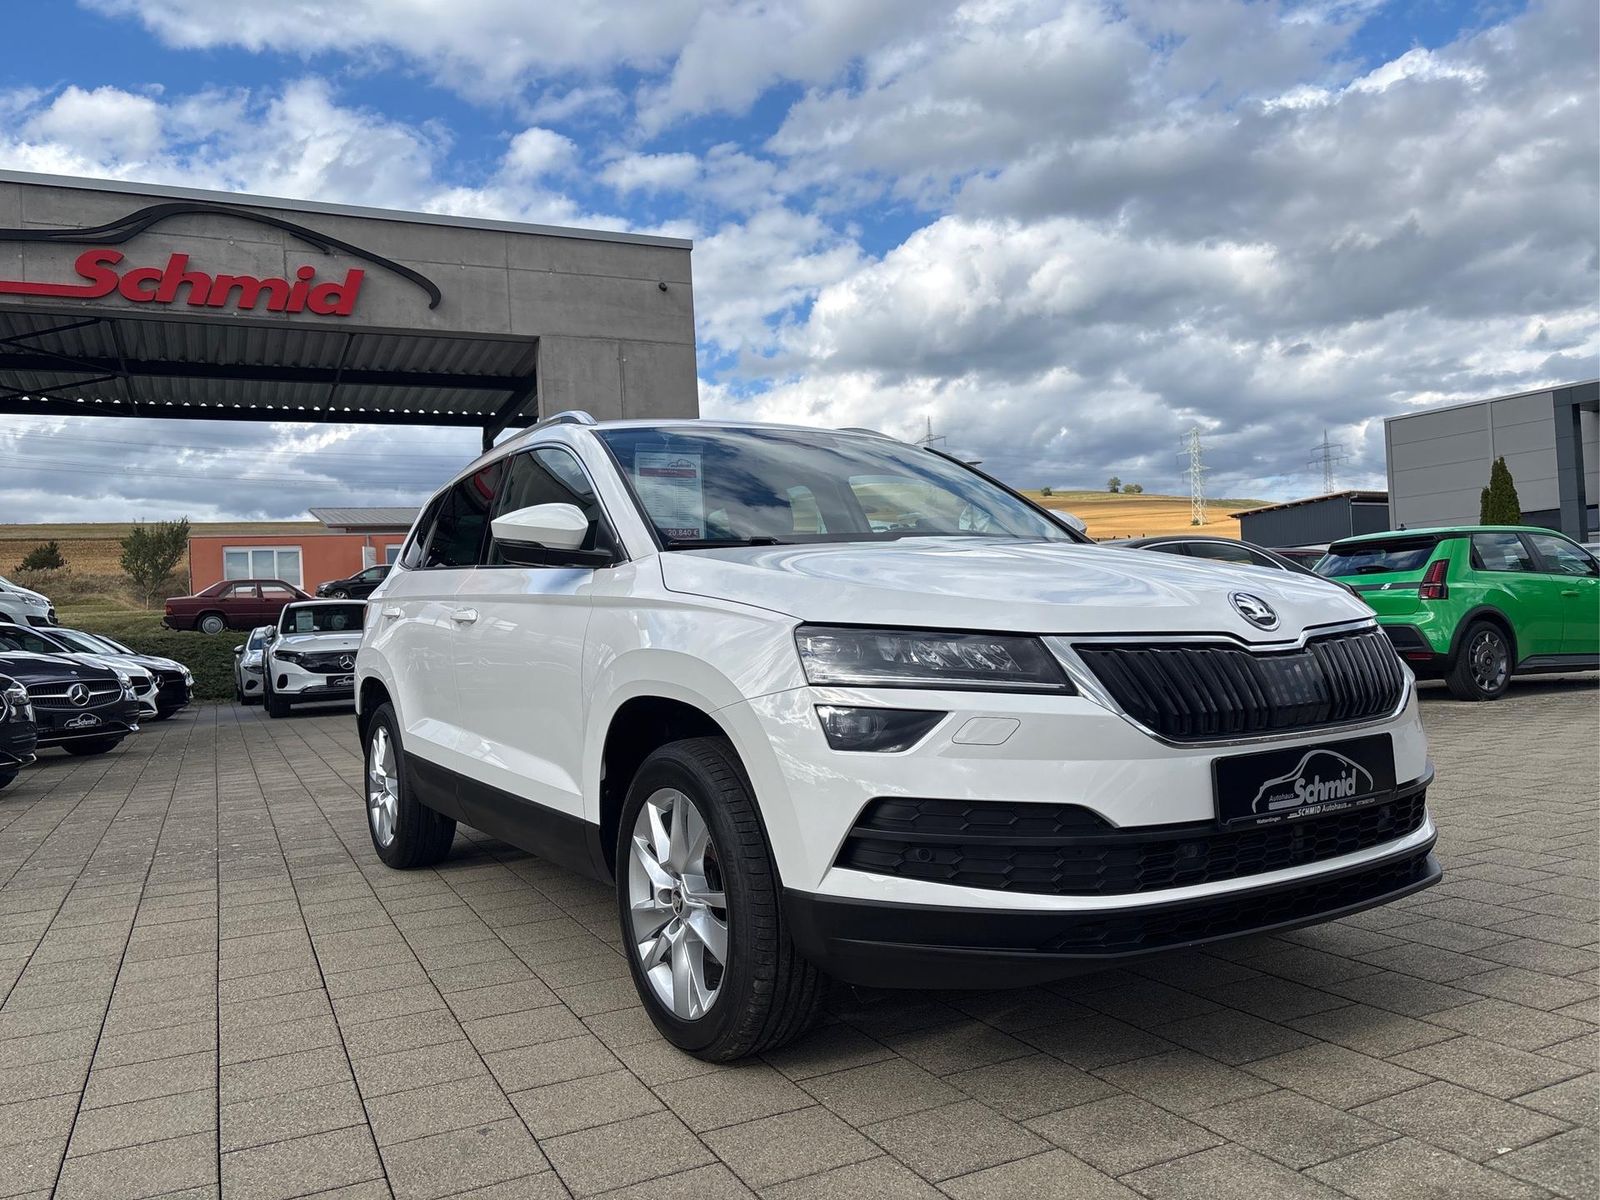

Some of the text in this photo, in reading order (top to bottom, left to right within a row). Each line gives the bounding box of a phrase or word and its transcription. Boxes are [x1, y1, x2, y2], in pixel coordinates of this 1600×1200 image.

[74, 249, 365, 315] Schmid
[77, 717, 96, 726] Schmid
[1269, 768, 1356, 804] Autohaus Schmid
[1298, 804, 1321, 817] SCHMID
